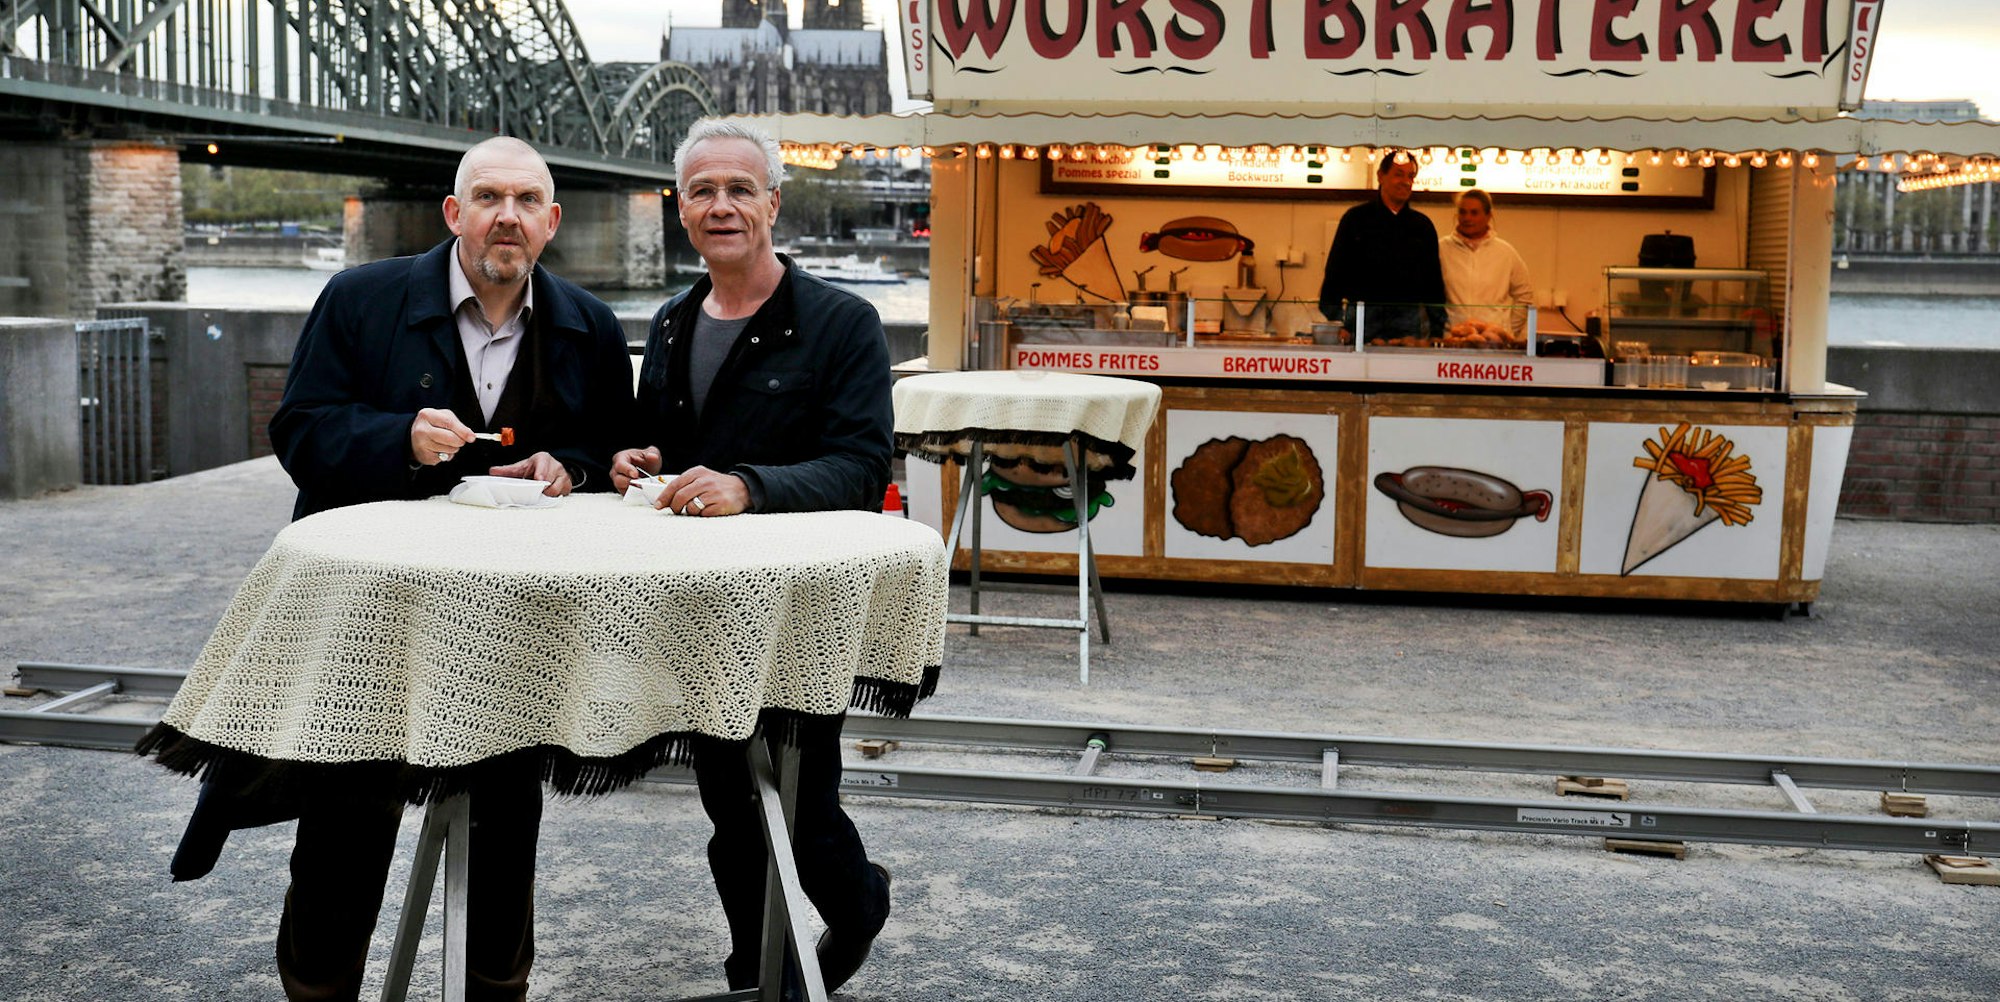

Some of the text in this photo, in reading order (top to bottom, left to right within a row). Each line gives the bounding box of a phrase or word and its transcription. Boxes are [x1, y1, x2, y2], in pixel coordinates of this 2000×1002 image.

[1058, 167, 1142, 180] Pommes spezial
[1228, 171, 1284, 182] Bockwurst
[1017, 351, 1160, 371] POMMES FRITES
[1223, 355, 1332, 375] BRATWURST
[1437, 362, 1534, 382] KRAKAUER
[1522, 815, 1552, 823] Precision
[1552, 816, 1570, 824] Vario
